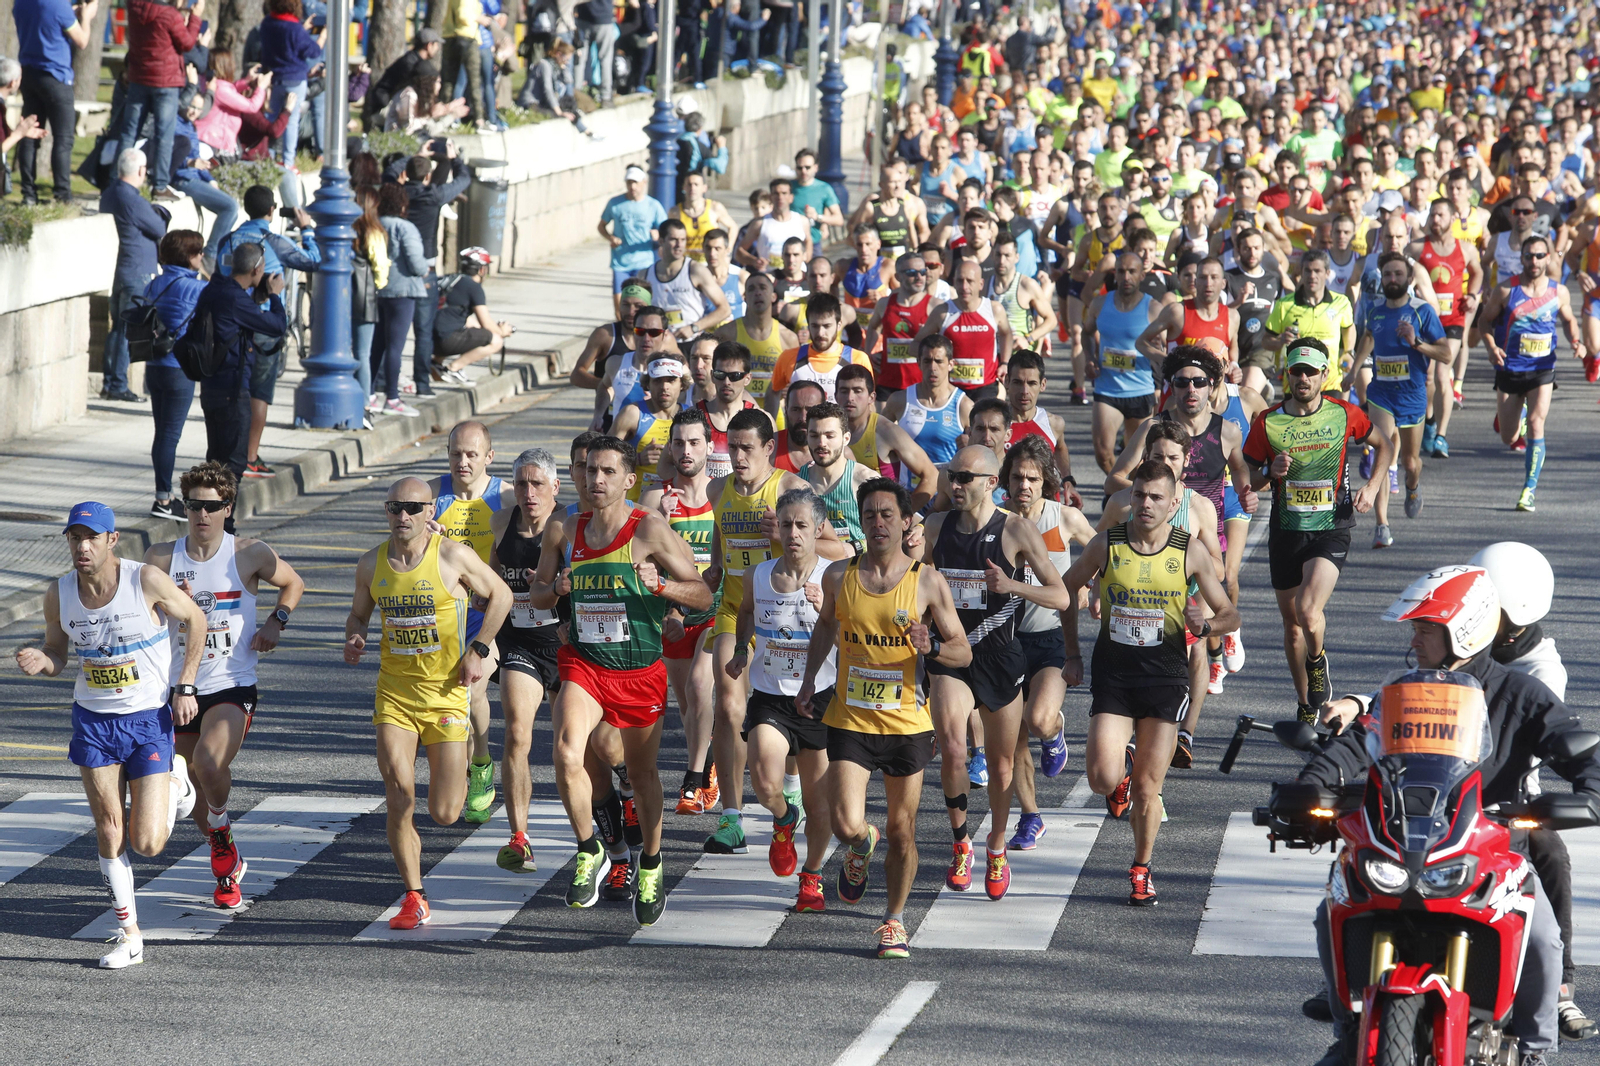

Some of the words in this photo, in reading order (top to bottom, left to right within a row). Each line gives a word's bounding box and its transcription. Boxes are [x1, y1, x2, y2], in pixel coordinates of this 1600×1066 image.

[1111, 356, 1125, 366] 164
[1381, 364, 1401, 374] 5047
[752, 380, 764, 391] 33
[1290, 428, 1333, 441] NOGASA
[1289, 443, 1330, 454] XTREMBIKE
[1296, 490, 1322, 503] 5241
[721, 511, 764, 522] ATHLETIC
[742, 551, 750, 566] 9
[176, 571, 194, 579] MILER
[573, 575, 626, 590] BIKILA
[377, 594, 434, 607] ATHLETICS
[528, 608, 534, 620] 8
[598, 622, 605, 634] 6
[1115, 618, 1160, 628] PREFERENTE
[395, 629, 429, 645] 5026
[1131, 627, 1141, 638] 16
[844, 631, 862, 645] U.D.
[865, 634, 908, 647] VÁRZEA
[788, 659, 794, 670] 3
[91, 669, 128, 685] 6534
[863, 682, 885, 700] 142
